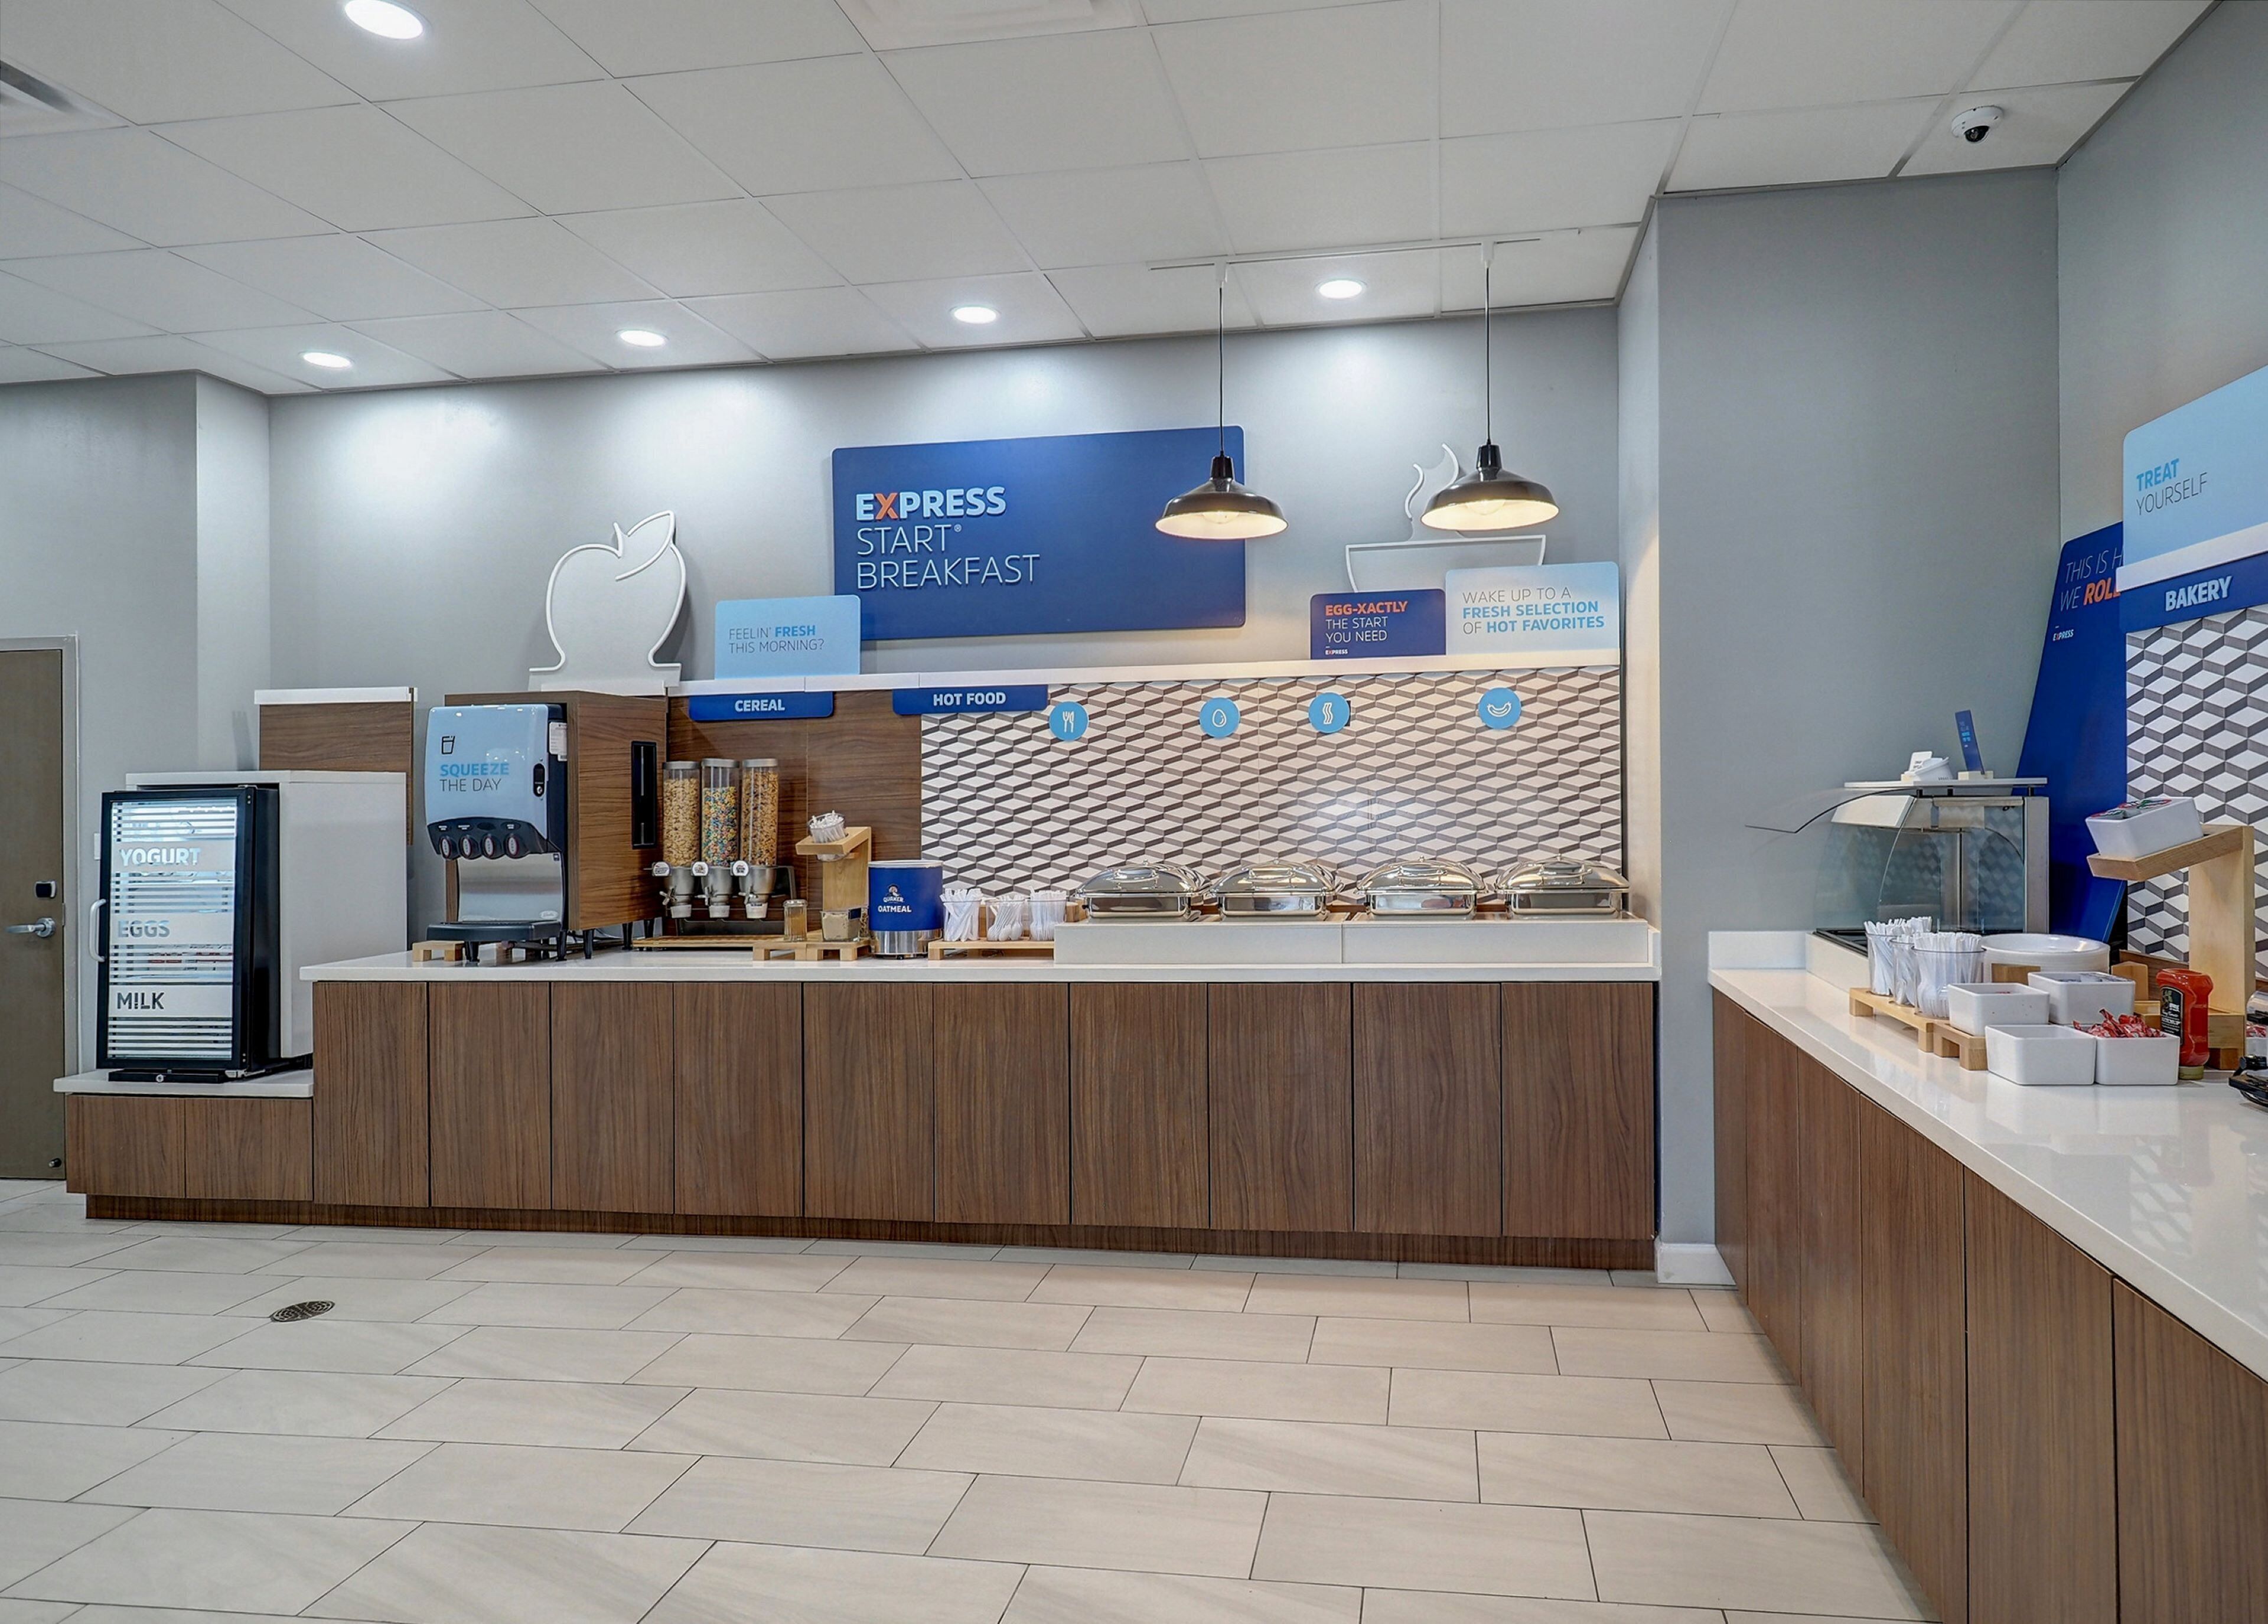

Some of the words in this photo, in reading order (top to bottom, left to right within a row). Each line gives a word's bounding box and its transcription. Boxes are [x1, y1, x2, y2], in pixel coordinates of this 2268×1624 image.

[2136, 458, 2179, 491] TREAT
[2136, 472, 2208, 516] YOURSELF
[856, 486, 1006, 521] EXPRESS
[857, 554, 1040, 589] BREAKFAST
[2065, 556, 2091, 583] THIS
[2096, 550, 2110, 574] IS
[1462, 590, 1506, 604] WAKE
[1511, 589, 1531, 602] UP
[1537, 588, 1556, 600] TO
[1561, 586, 1572, 599] A
[2060, 586, 2081, 612] WE
[2165, 576, 2233, 612] BAKERY
[1325, 601, 1408, 617] EGG-XACTLY
[1462, 605, 1510, 619] FRESH
[1516, 601, 1598, 616] SELECTION
[1325, 618, 1348, 630] THE
[1352, 616, 1388, 628] START
[1462, 621, 1482, 635] OF
[1487, 619, 1516, 633] HOT
[1523, 616, 1605, 631] FAVORITES
[729, 626, 771, 640] FEELIN'
[775, 625, 816, 637] FRESH
[1325, 632, 1351, 644] YOU
[1355, 630, 1387, 642] NEED
[2052, 629, 2074, 641] EXPRESS
[729, 641, 755, 654] THIS
[758, 638, 825, 653] MORNING?
[734, 699, 786, 712] CEREAL
[933, 693, 963, 706] HOT
[966, 692, 1006, 705] FOOD
[439, 763, 509, 777] SQUEEZE
[439, 778, 467, 791] THE
[472, 778, 501, 791] DAY
[120, 848, 201, 866] YOGURT
[118, 920, 170, 938] EGGS
[116, 992, 164, 1009] MILK
